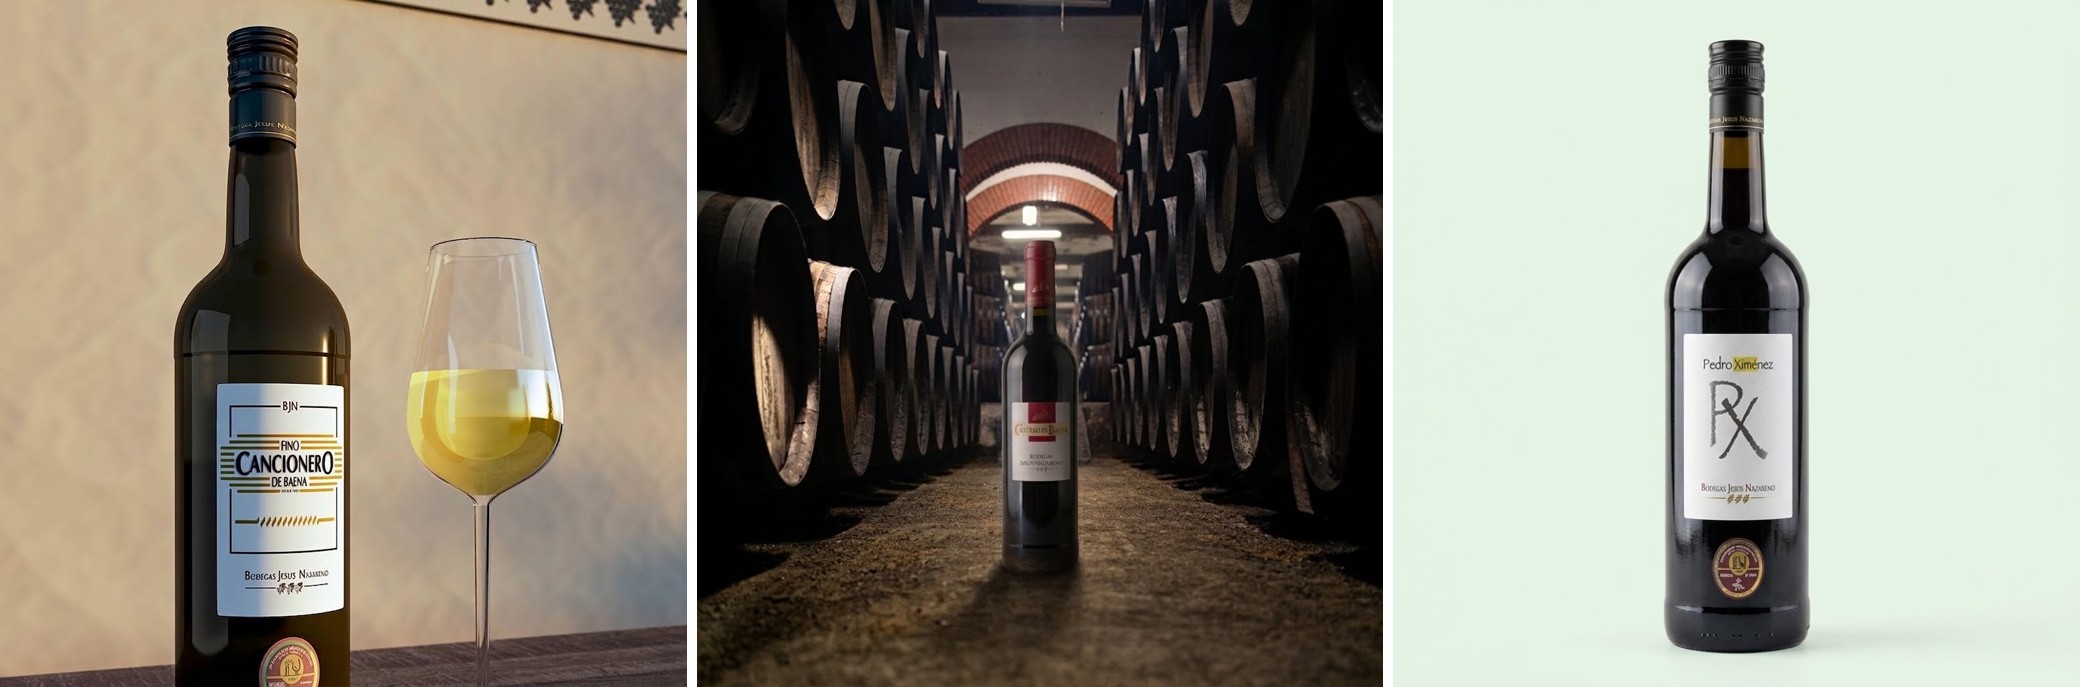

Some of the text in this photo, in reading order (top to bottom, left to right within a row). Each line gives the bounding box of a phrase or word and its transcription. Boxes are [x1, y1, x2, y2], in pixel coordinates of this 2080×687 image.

[1703, 355, 1774, 370] Pedro Ximénez
[282, 401, 298, 413] BJN
[281, 440, 300, 451] FINO
[235, 451, 334, 476] CANCIONERO
[271, 476, 308, 487] DE BAENA
[245, 570, 276, 580] BODEGAS
[277, 570, 296, 582] JESUS
